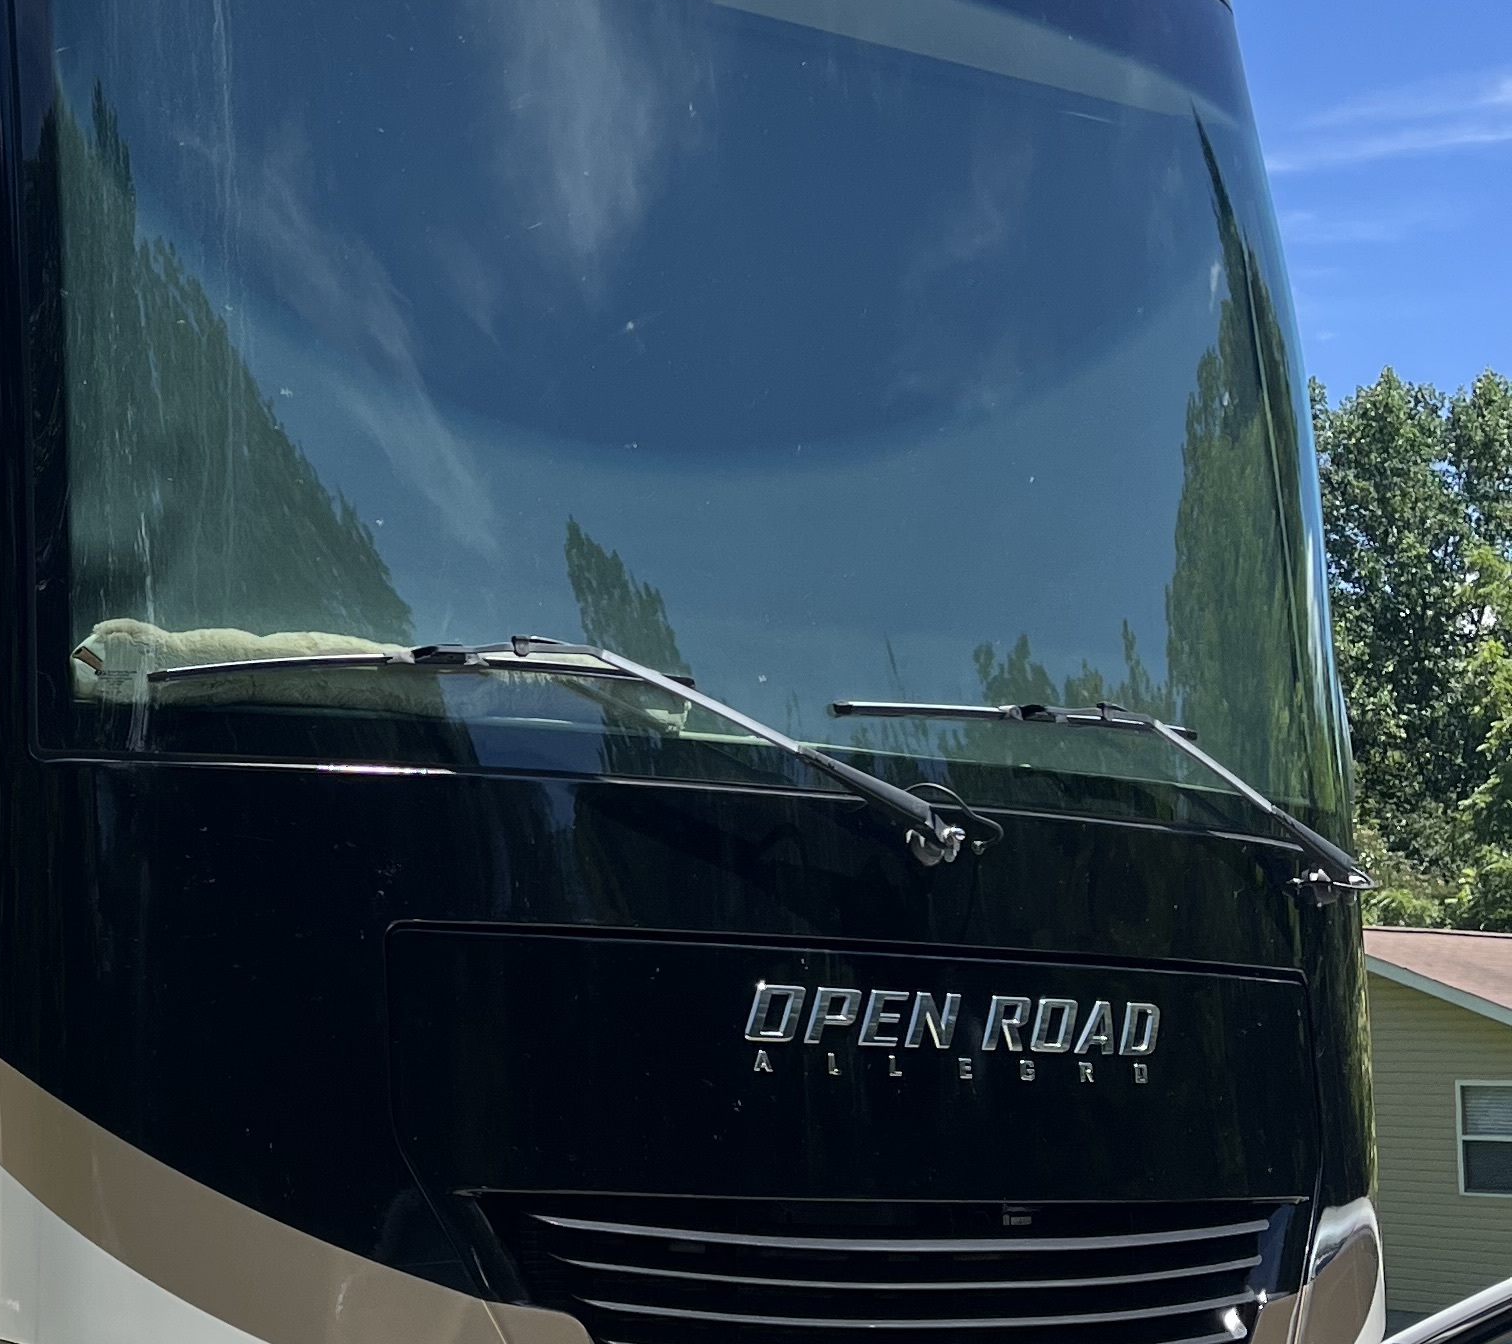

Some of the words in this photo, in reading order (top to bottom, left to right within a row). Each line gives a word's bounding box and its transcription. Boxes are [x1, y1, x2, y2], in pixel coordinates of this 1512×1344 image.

[745, 983, 962, 1048] OPEN
[981, 995, 1162, 1055] ROAD
[752, 1049, 1150, 1084] ALLEGRO
